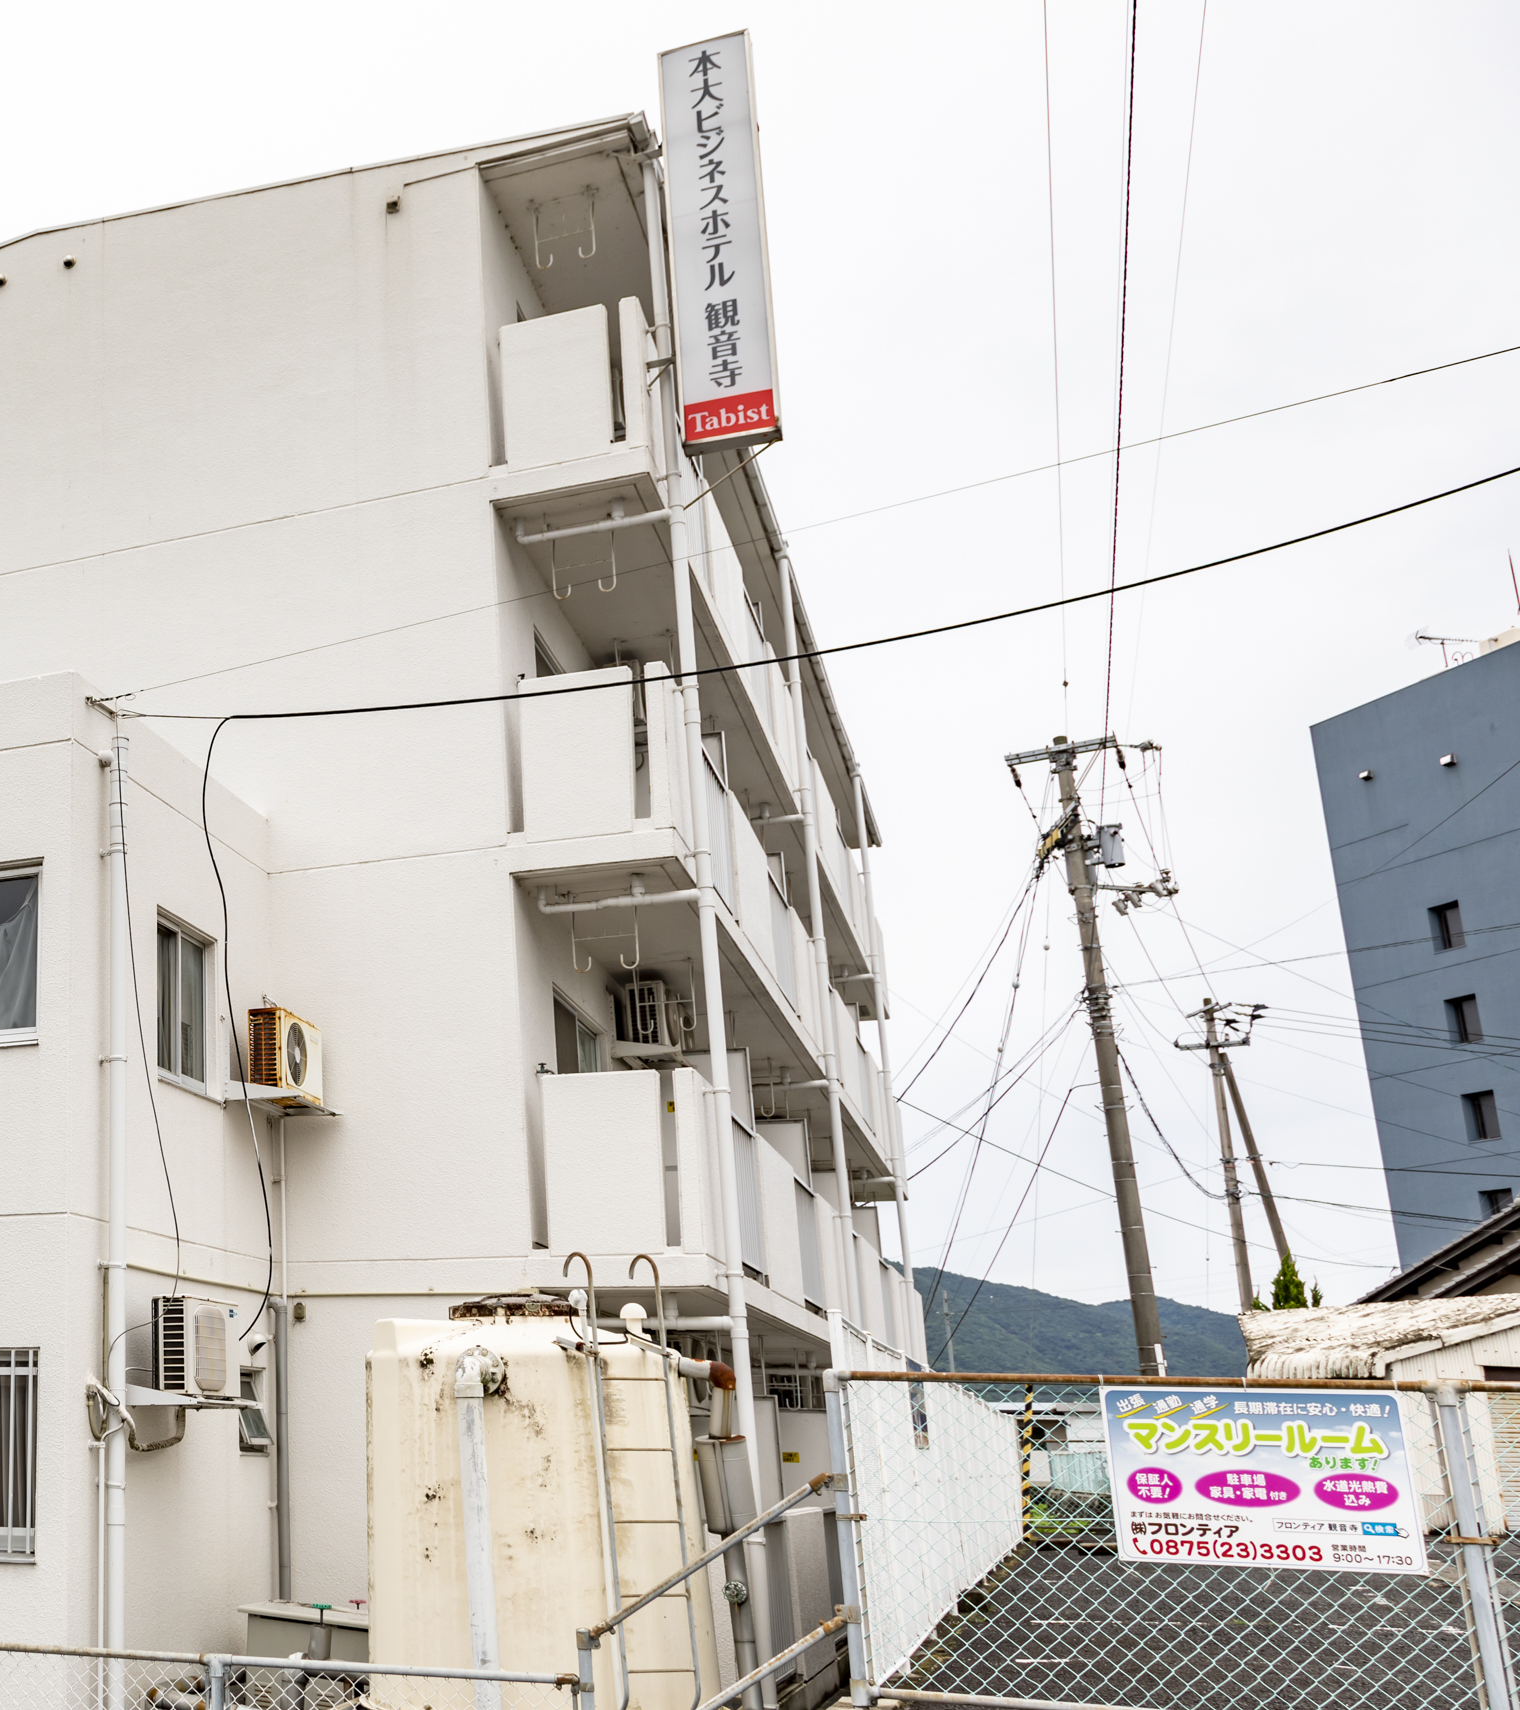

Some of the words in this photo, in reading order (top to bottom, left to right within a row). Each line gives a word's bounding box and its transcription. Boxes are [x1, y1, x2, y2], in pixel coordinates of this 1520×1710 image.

[688, 50, 736, 292] 本大ビジネスホテル
[704, 299, 743, 389] 観音寺
[688, 402, 771, 433] Tabist
[1116, 1393, 1147, 1413] 出張
[1152, 1394, 1183, 1414] 通勤
[1189, 1395, 1219, 1415] 通学
[1125, 1419, 1386, 1457] マンスリールーム
[1308, 1456, 1378, 1471] あります!
[1135, 1473, 1173, 1486] 保証人
[1226, 1473, 1267, 1486] 駐車場
[1322, 1480, 1388, 1494] 水道光熱費
[1269, 1491, 1288, 1500] 付き
[1343, 1494, 1371, 1506] 込み
[1276, 1521, 1325, 1531] フロンティア
[1149, 1538, 1323, 1562] 0875(23)3303
